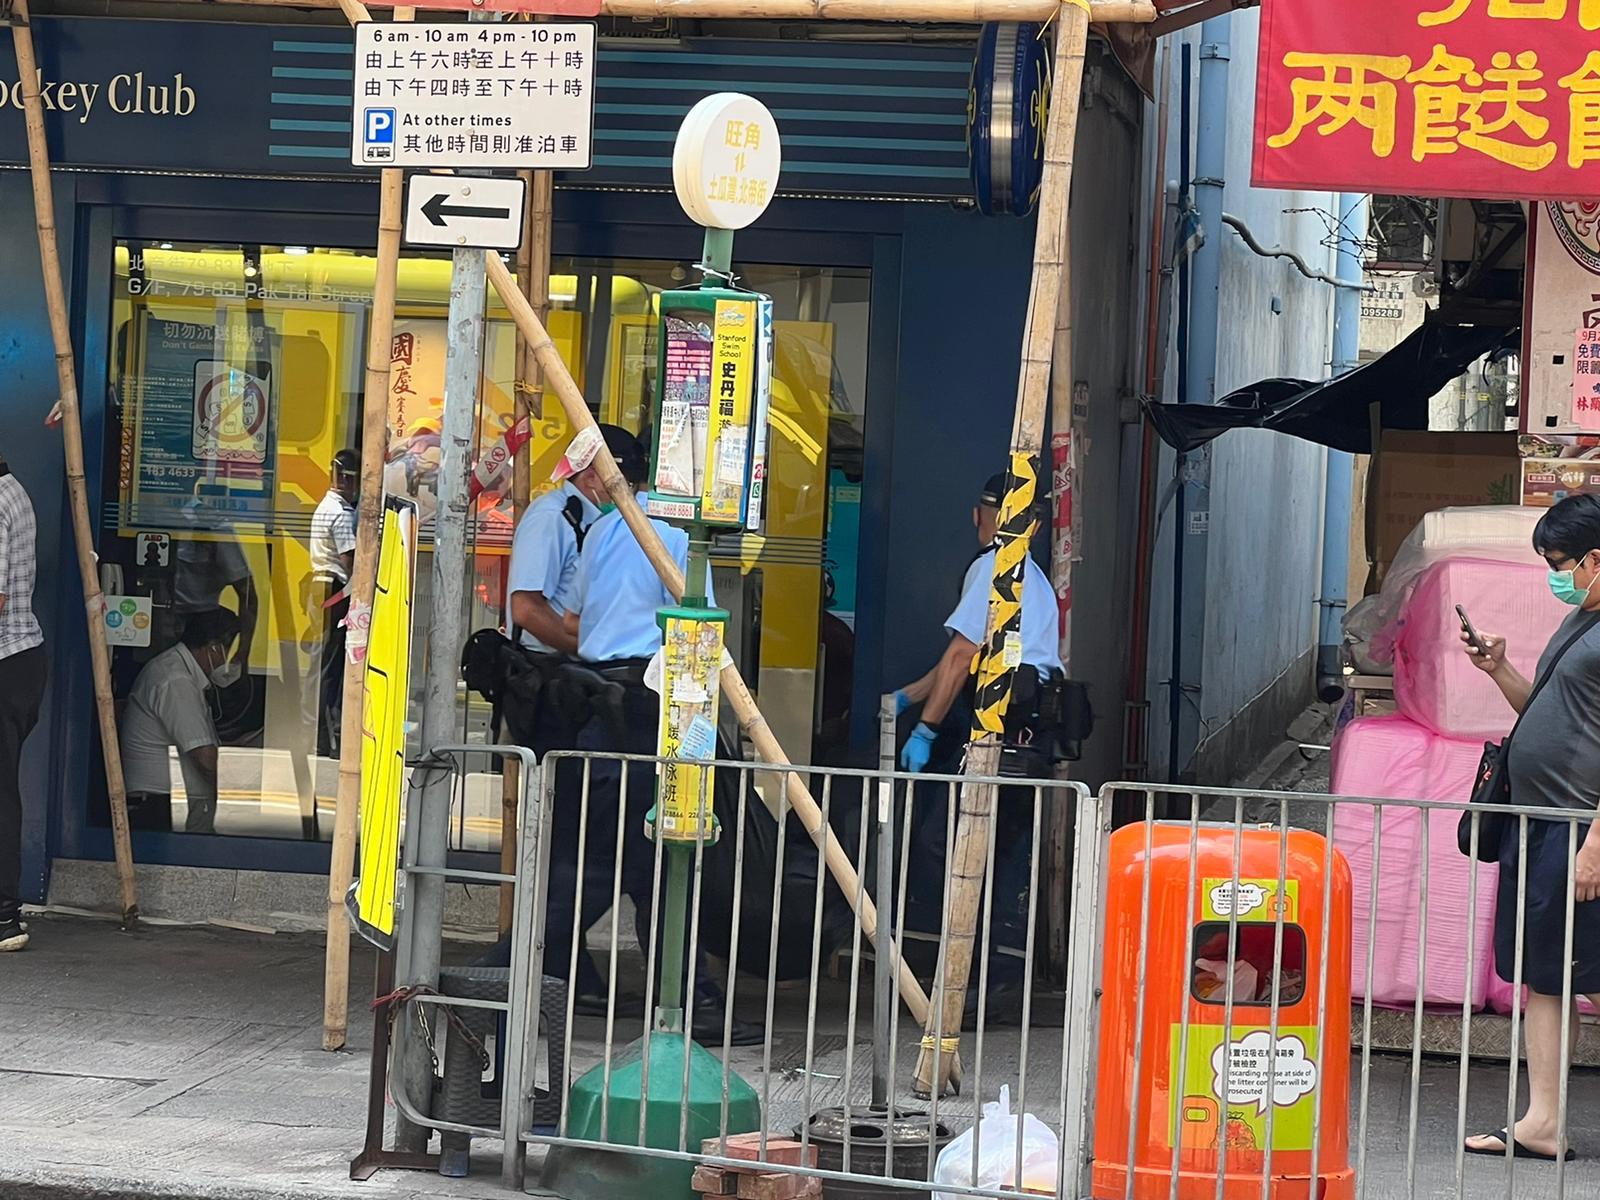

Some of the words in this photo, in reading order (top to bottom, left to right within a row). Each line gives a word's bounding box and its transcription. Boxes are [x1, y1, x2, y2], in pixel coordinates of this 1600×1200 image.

[373, 29, 383, 42] 6
[388, 31, 409, 42] am
[425, 29, 442, 42] 10
[447, 31, 469, 42] am
[478, 29, 488, 42] 4
[493, 31, 516, 46] pm
[531, 29, 549, 43] 10
[553, 31, 577, 46] pm
[366, 50, 583, 70] 由上午六時至上午十時
[107, 71, 196, 116] Club
[364, 77, 583, 97] 由下午四時至下午十時
[403, 114, 420, 126] At
[425, 114, 465, 126] other
[470, 113, 512, 126] times
[725, 120, 760, 150] 旺角
[403, 134, 578, 154] 其他時間則准泊車
[182, 280, 237, 297] 79-83
[245, 282, 280, 299] Pak
[285, 284, 312, 301] Tai
[319, 285, 376, 302] Stree
[718, 333, 747, 343] Stanford
[721, 342, 741, 350] Swim
[719, 351, 742, 359] School
[1229, 1070, 1261, 1078] iscarding
[1237, 1078, 1254, 1086] litter
[1228, 1087, 1263, 1096] rosecuted
